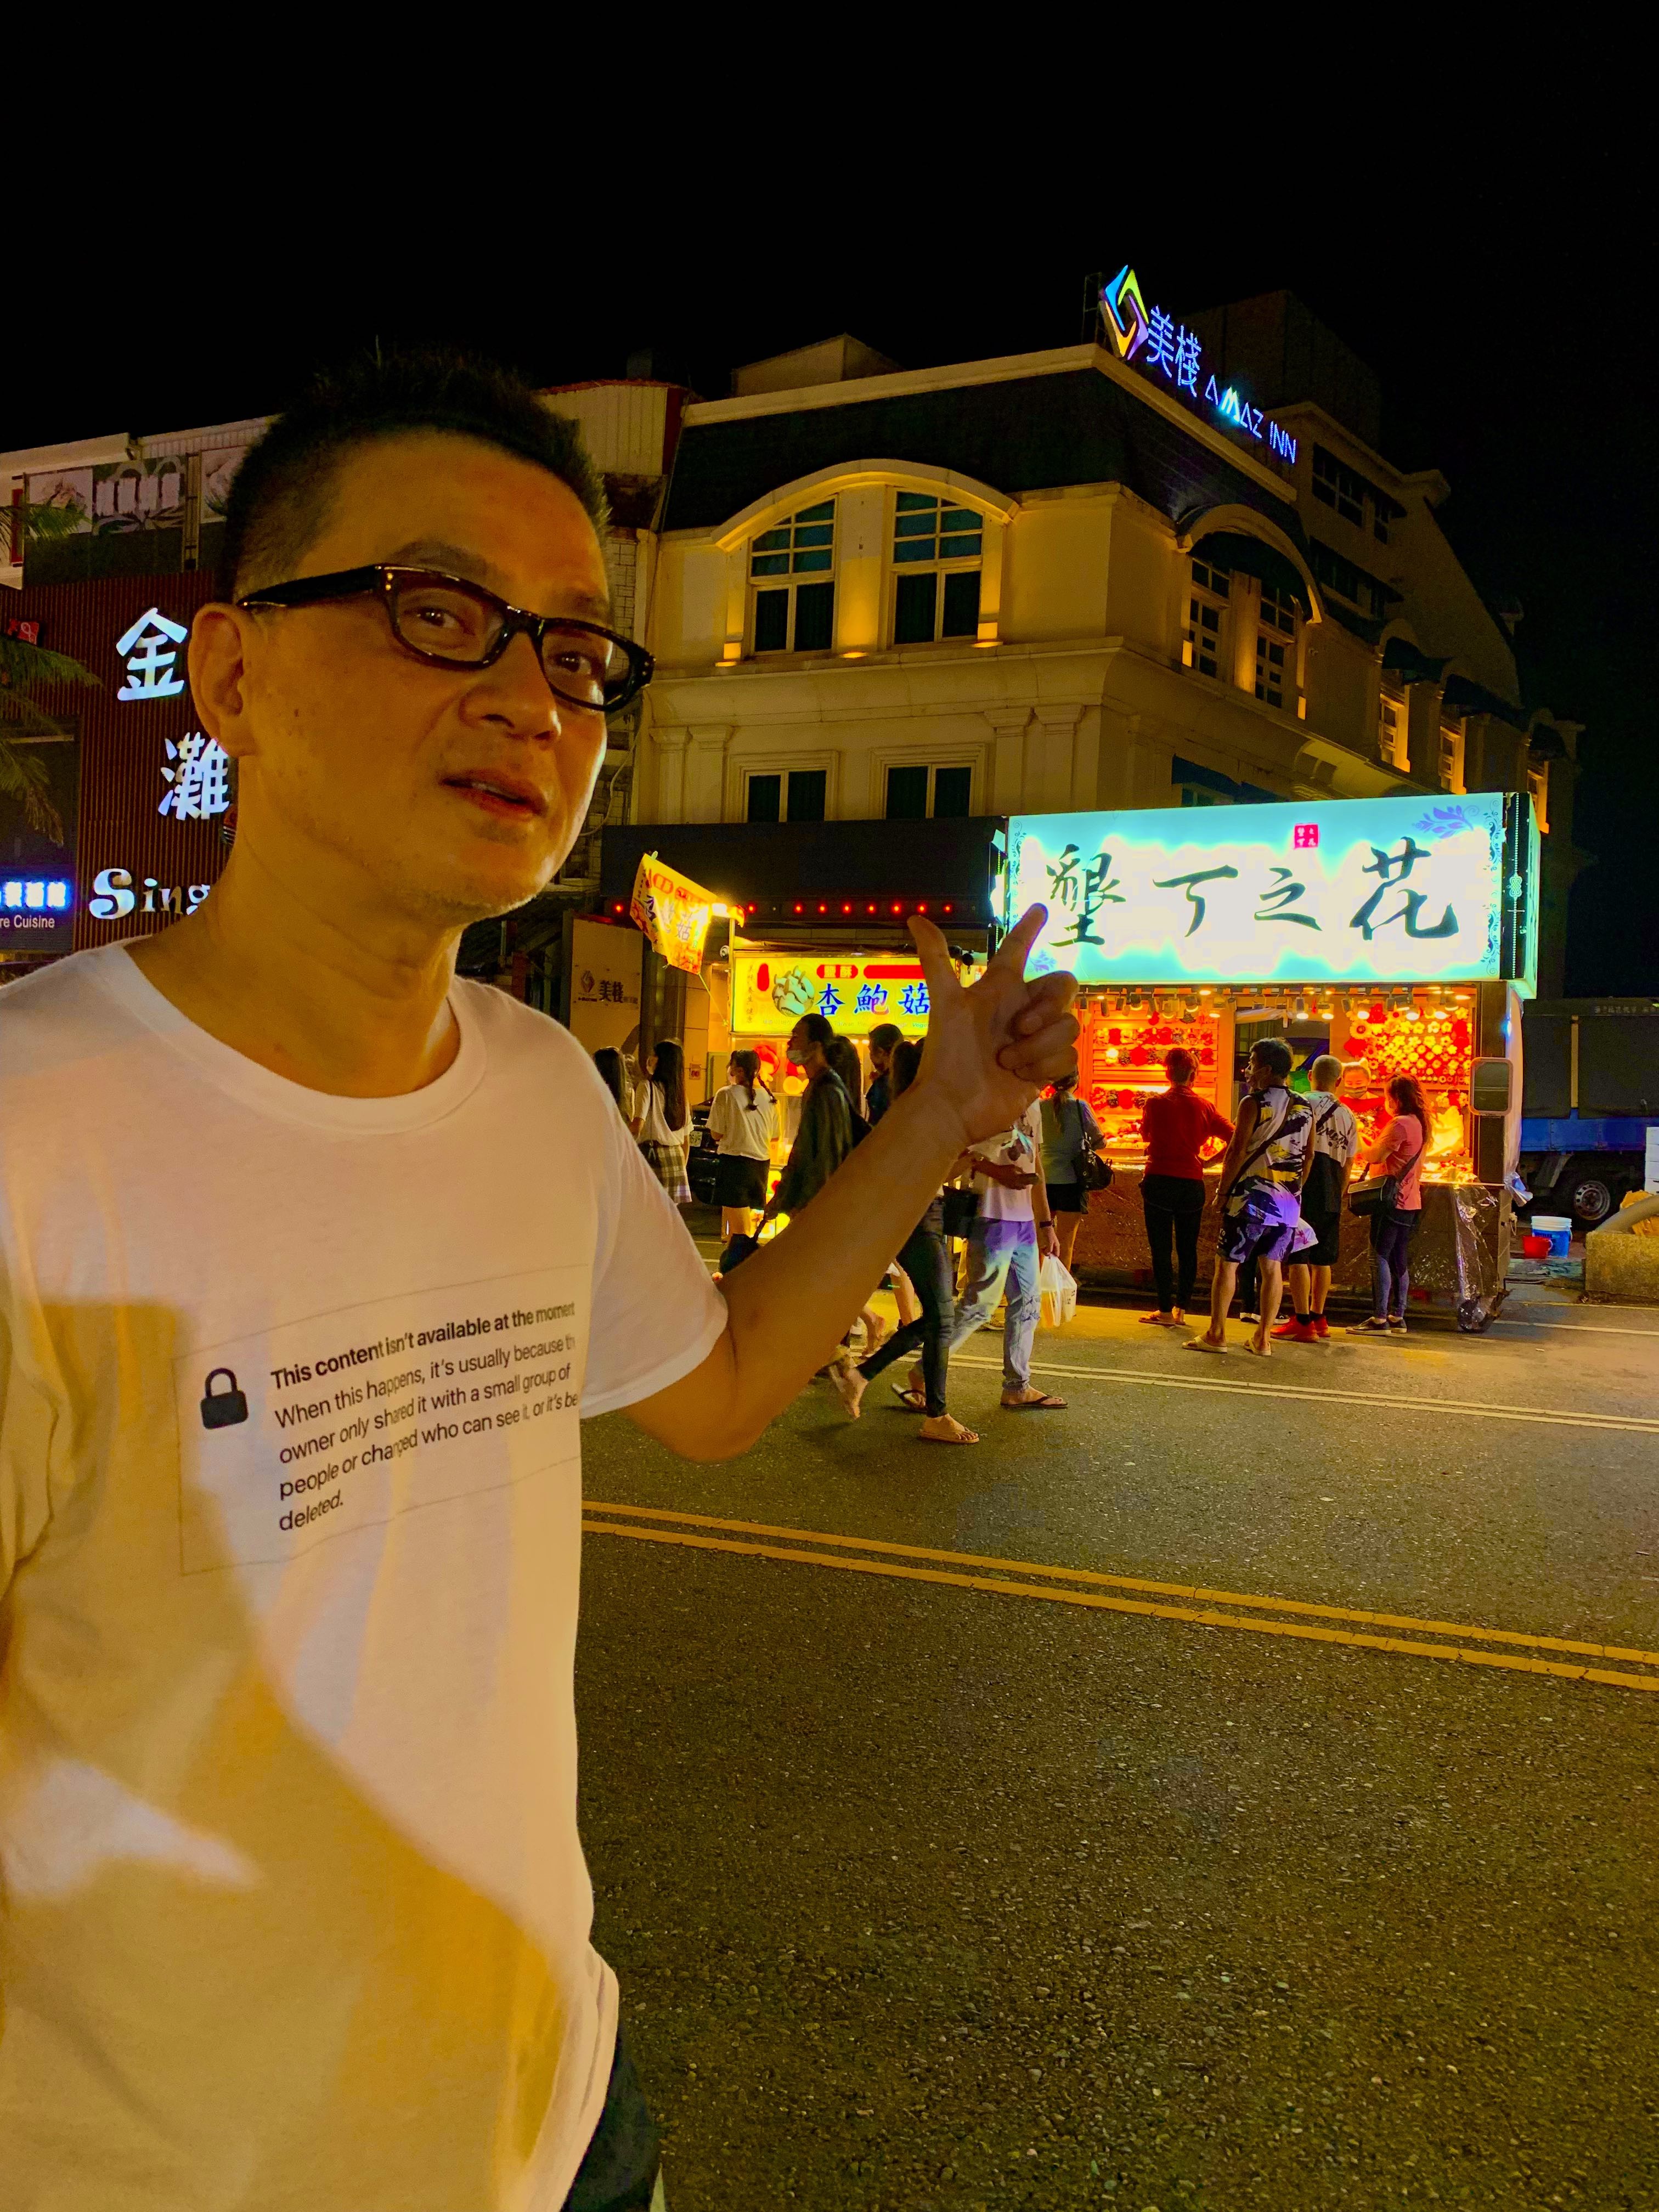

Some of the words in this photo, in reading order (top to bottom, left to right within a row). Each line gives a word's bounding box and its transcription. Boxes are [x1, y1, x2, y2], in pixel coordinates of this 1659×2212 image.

[1269, 421, 1296, 464] INN
[815, 983, 930, 1018] 杏鮑菇
[270, 1364, 312, 1390] This
[315, 1340, 385, 1376] content
[417, 1317, 491, 1346] available
[494, 1314, 510, 1331] at
[512, 1310, 534, 1328] the
[275, 1399, 331, 1429] When
[335, 1386, 363, 1410] this
[366, 1368, 425, 1400] happens,
[459, 1347, 510, 1373] usually
[514, 1338, 563, 1362] because
[280, 1432, 335, 1464] owner
[339, 1417, 369, 1443] only
[374, 1397, 414, 1429] shared
[418, 1396, 427, 1414] it
[431, 1387, 466, 1409] with
[470, 1388, 479, 1401] a
[484, 1374, 521, 1400] small
[522, 1369, 557, 1394] group
[558, 1363, 571, 1380] of
[280, 1463, 339, 1501] people
[342, 1455, 358, 1474] or
[421, 1423, 459, 1444] who
[462, 1416, 493, 1435] can
[496, 1409, 520, 1427] see
[279, 1489, 344, 1531] deleted.
